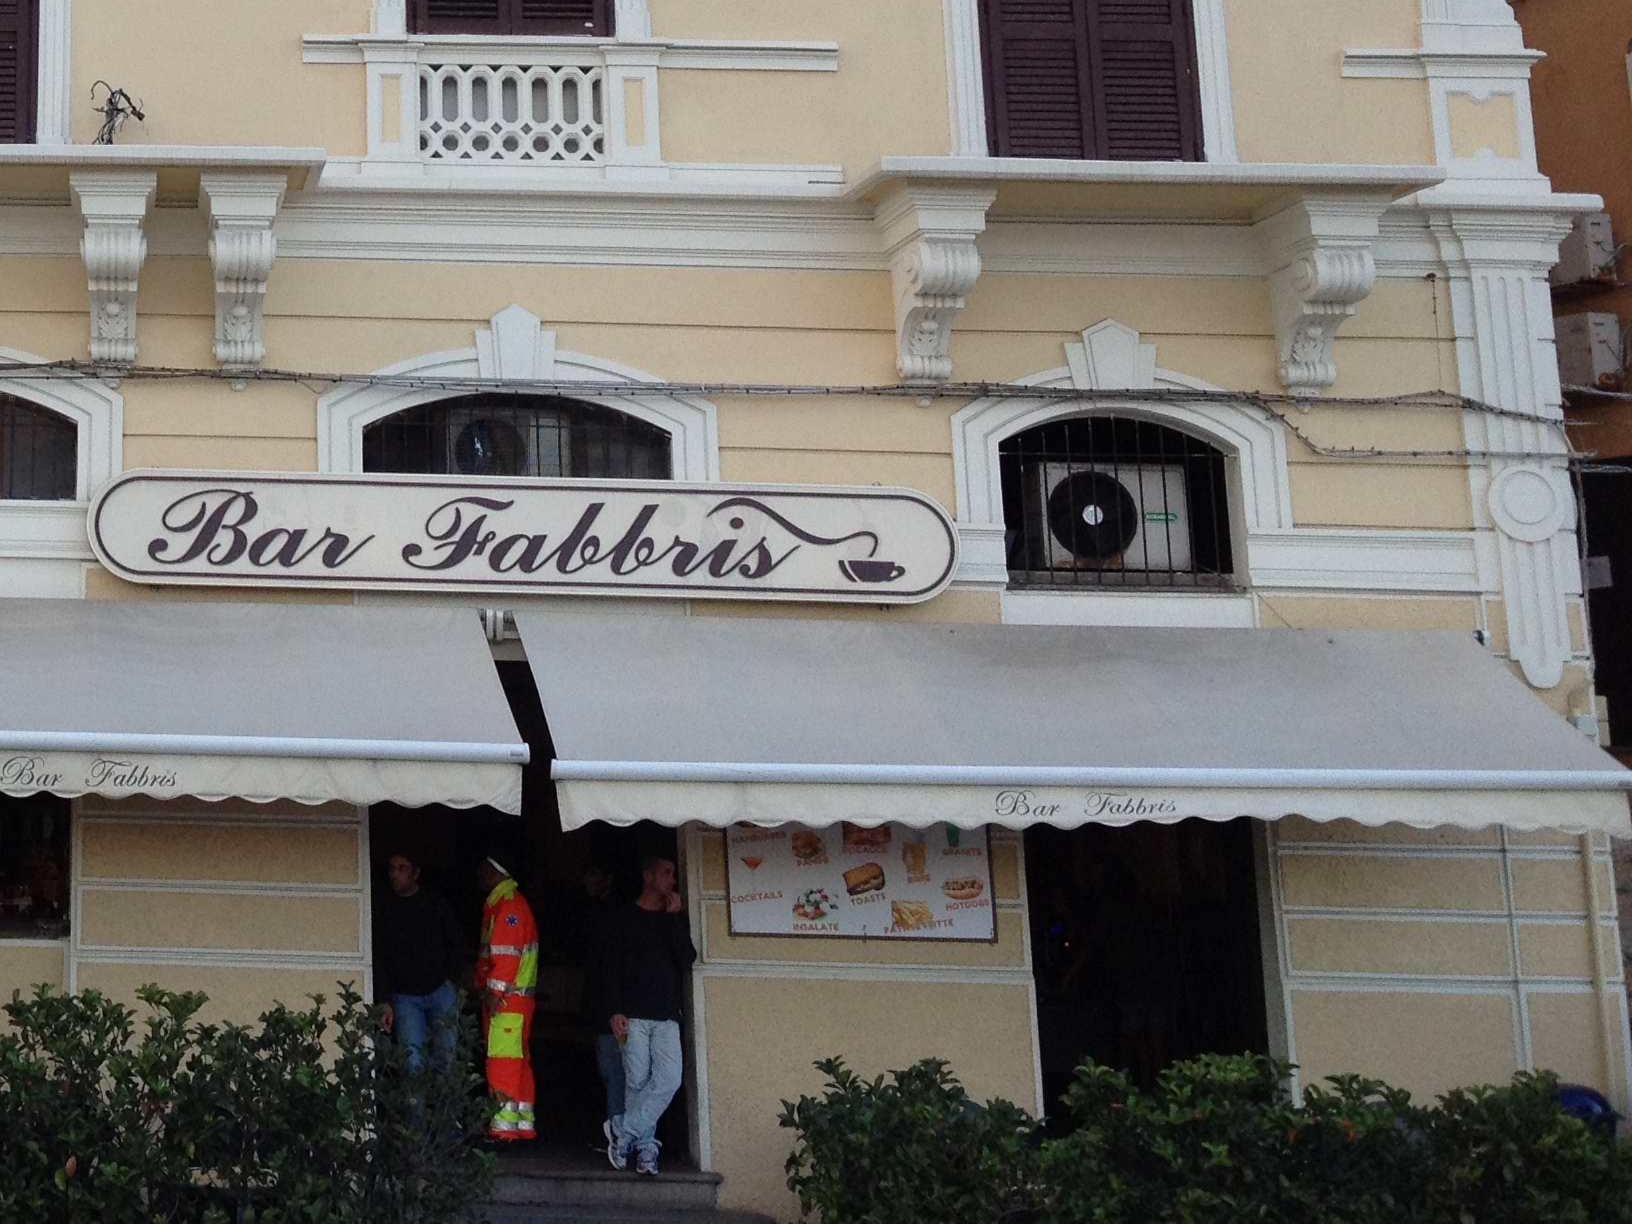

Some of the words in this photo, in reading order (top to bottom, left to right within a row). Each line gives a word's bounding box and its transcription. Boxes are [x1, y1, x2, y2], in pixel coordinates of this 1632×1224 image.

[148, 488, 376, 568] Bar
[402, 495, 802, 577] Fabbris
[0, 756, 64, 787] Bar
[84, 758, 177, 788] Fabbris
[995, 789, 1060, 817] Bar
[1083, 790, 1177, 817] Fabbris
[731, 891, 783, 903] COCKTAILS
[851, 893, 886, 905] TOASTS
[793, 923, 839, 931] INSALATE
